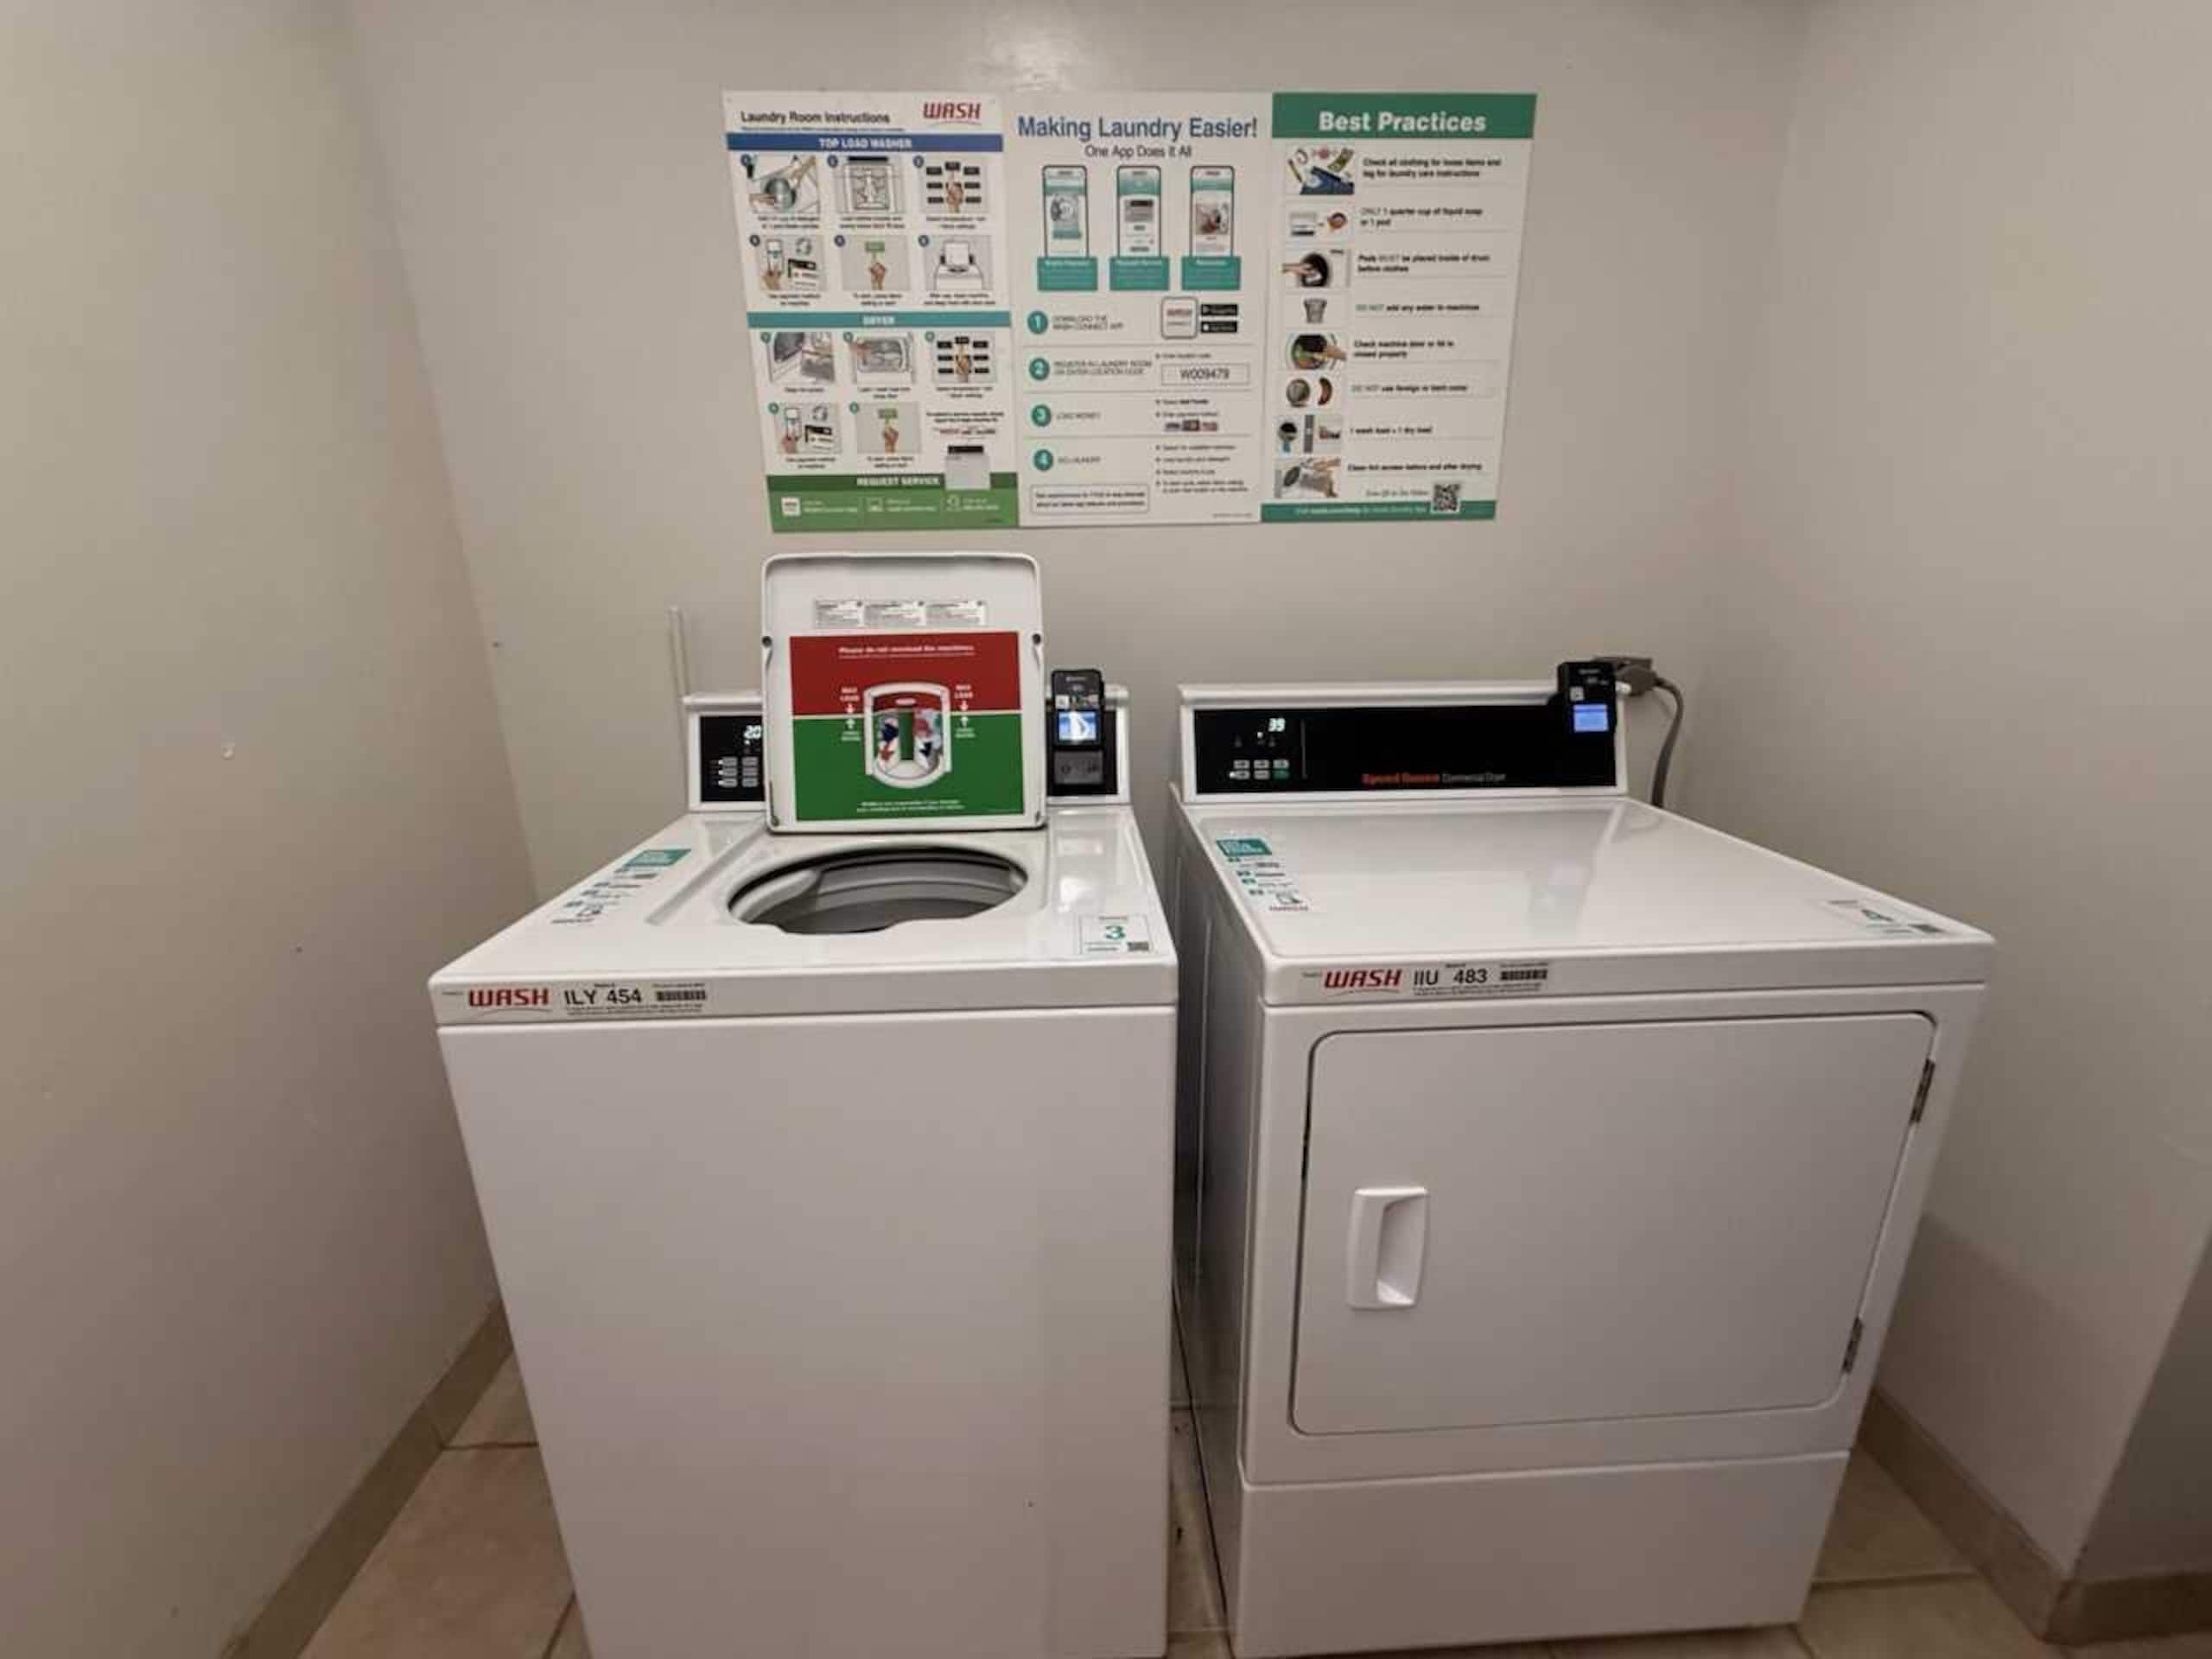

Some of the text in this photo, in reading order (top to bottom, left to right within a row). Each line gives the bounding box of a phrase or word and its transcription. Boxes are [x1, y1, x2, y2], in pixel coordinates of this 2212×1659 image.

[741, 111, 891, 125] Laundry Room Instructions
[923, 102, 982, 120] WASH
[1319, 111, 1487, 130] Best Practices
[1017, 116, 1258, 142] Making Laundry Easier!
[819, 138, 840, 150] TOP
[842, 138, 868, 150] LOAD
[1084, 144, 1109, 157] One
[1112, 144, 1134, 160] App
[1137, 144, 1165, 157] Does
[1179, 144, 1192, 157] All
[1034, 314, 1041, 329] 1
[1035, 361, 1045, 375] 2
[1037, 409, 1046, 423] 3
[1038, 453, 1048, 467] 4
[1105, 925, 1126, 940] 3
[1324, 969, 1489, 988] WASH IIU 483
[467, 988, 642, 1007] WASH ILY 454
